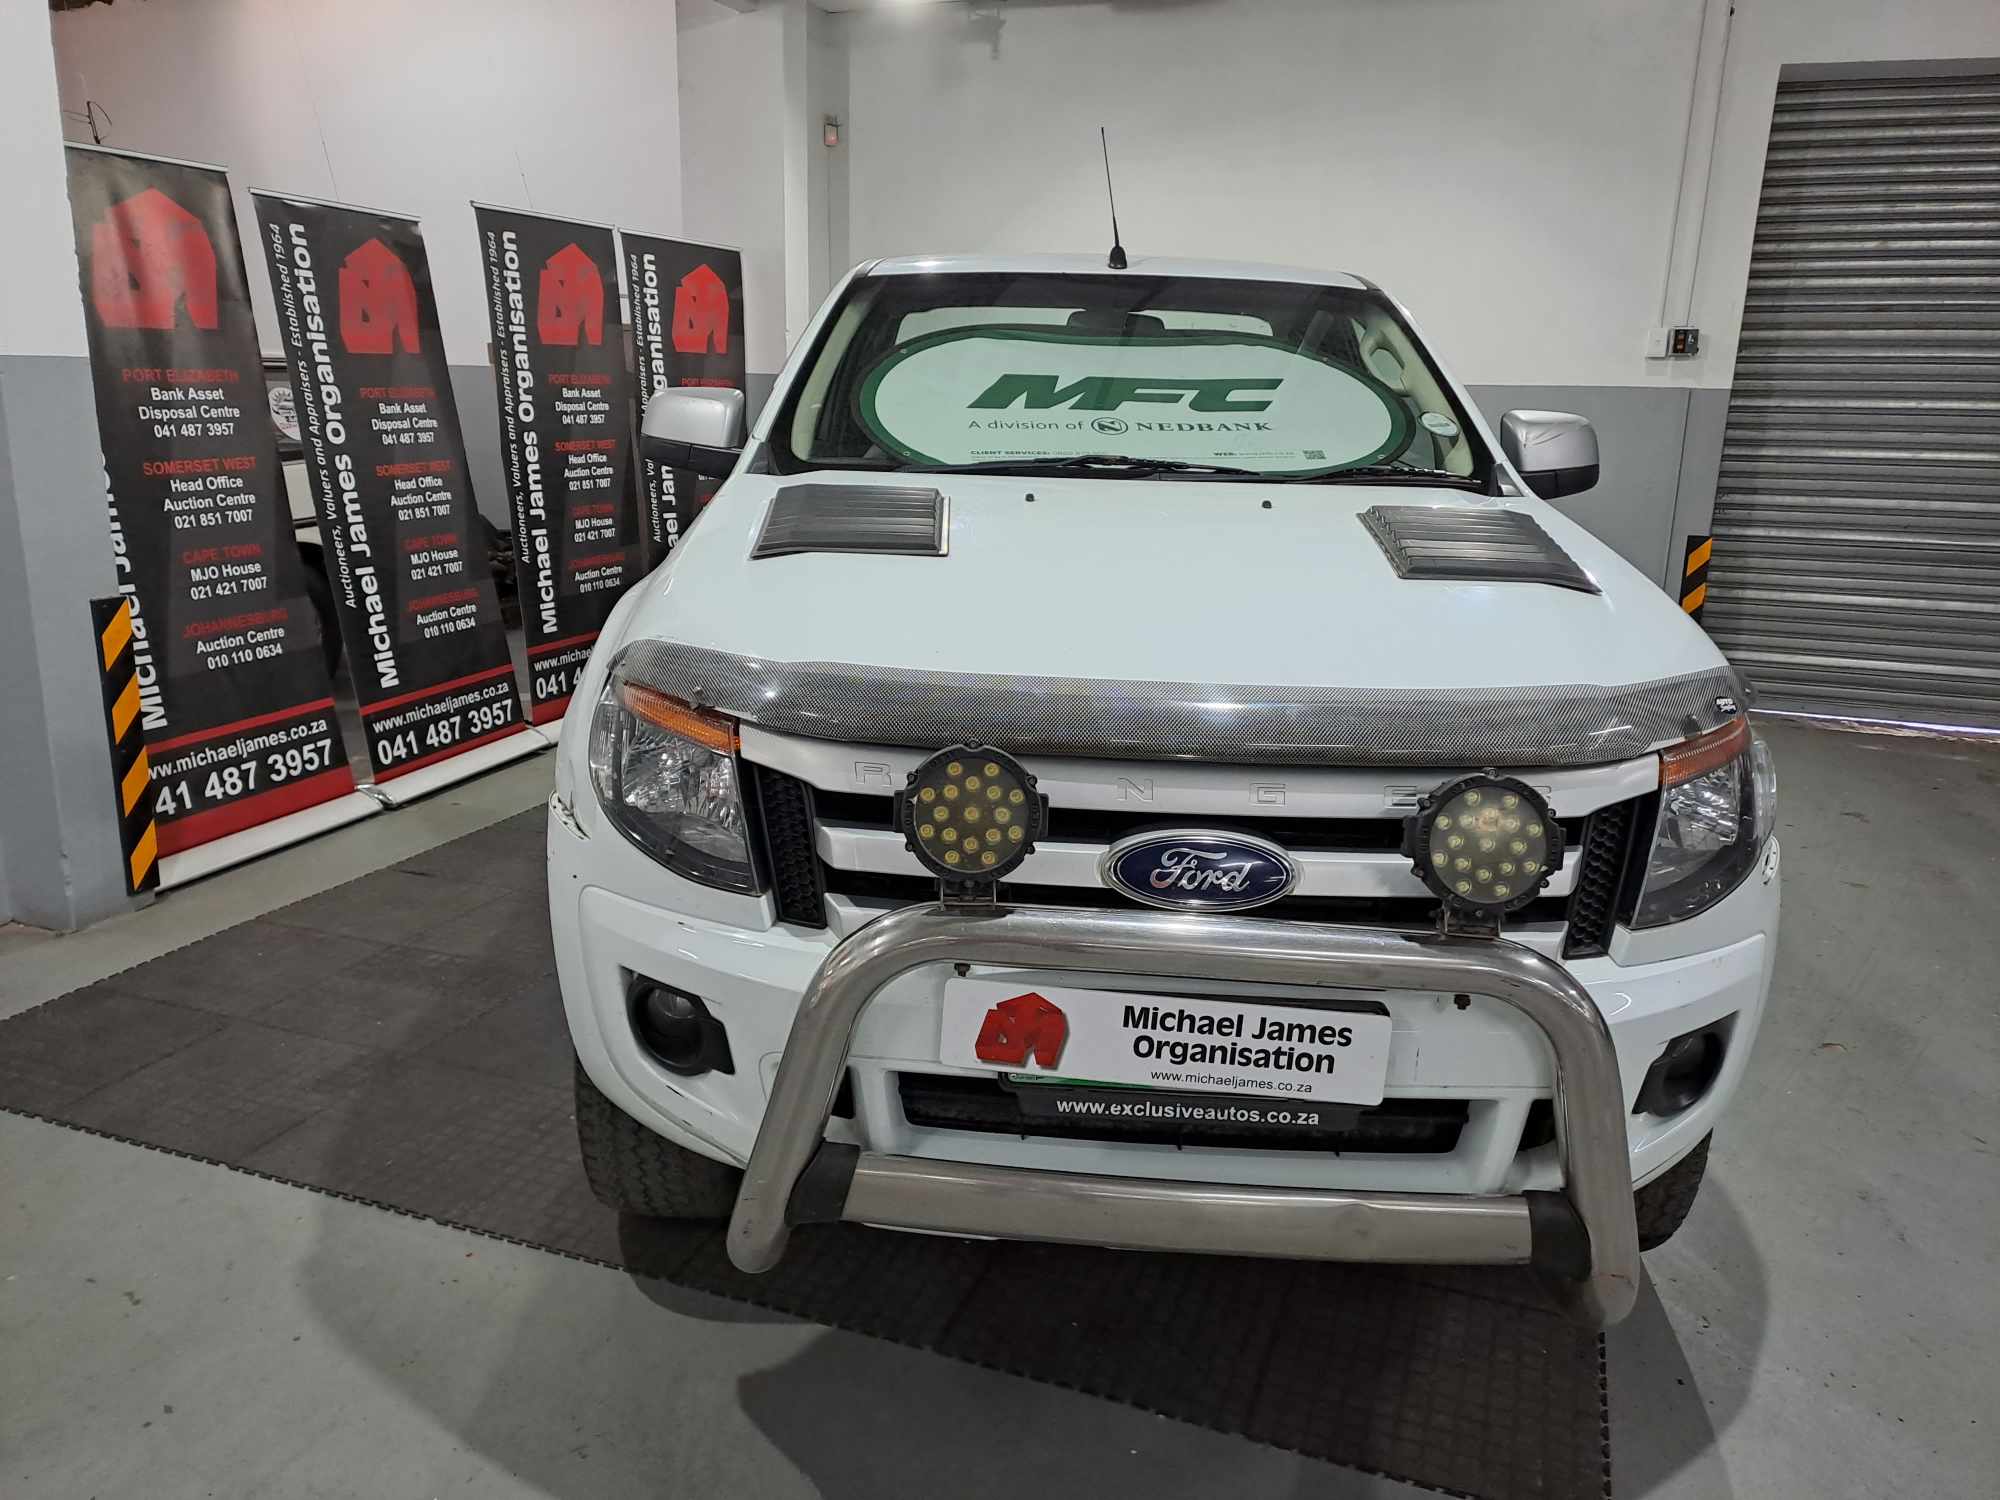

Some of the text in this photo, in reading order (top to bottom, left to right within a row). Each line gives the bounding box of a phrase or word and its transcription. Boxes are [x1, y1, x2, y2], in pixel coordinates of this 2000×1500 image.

[150, 387, 225, 401] Bank Asset
[487, 231, 531, 564] Auctioneers, Valuers and Appraisers Established 1964
[966, 373, 1284, 412] MFC
[138, 405, 240, 421] Disposal Centre
[269, 223, 357, 608] Auctioneers, Valuers and Appraisers Established 1964
[379, 402, 427, 414] Bank Asset
[154, 422, 234, 438] 041 487 3957
[371, 417, 438, 431] Disposal Centre
[502, 231, 558, 634] Michael James Organisation
[968, 420, 1272, 432] A division of NEDBANK
[382, 431, 434, 445] 041 487 3957
[143, 456, 256, 475] SOMERSET WEST
[289, 223, 400, 689] Michael James Organisation
[170, 476, 243, 492] Head Office
[394, 475, 443, 490] Head Office
[163, 493, 256, 511] Auction Centre
[391, 490, 452, 507] Auction Centre
[174, 509, 253, 529] 021 851 7007
[398, 504, 450, 520] 021 851 7007
[410, 549, 458, 565] MJO House
[190, 562, 262, 582] MJO House
[410, 561, 463, 580] 021 421 7007
[190, 576, 268, 600] 021 421 7007
[416, 603, 477, 625] Auction Centre
[424, 617, 476, 639] 010 110 0634
[196, 626, 285, 654] Auction Centre
[207, 643, 283, 670] 010 110 0634
[535, 671, 567, 700] 041
[372, 682, 509, 733] www.michaeljames.co.za
[377, 698, 513, 765] 041 487 3957
[148, 719, 328, 780] ww.michaeljames.co.za
[155, 738, 332, 816] 41 487 3957
[1150, 847, 1264, 892] Ford
[1122, 1005, 1353, 1048] Michael James
[1133, 1034, 1336, 1074] Organisation
[1151, 1071, 1313, 1093] www.michaeljames.co.za
[1056, 1099, 1320, 1126] www.exclusiveautos.co.za
